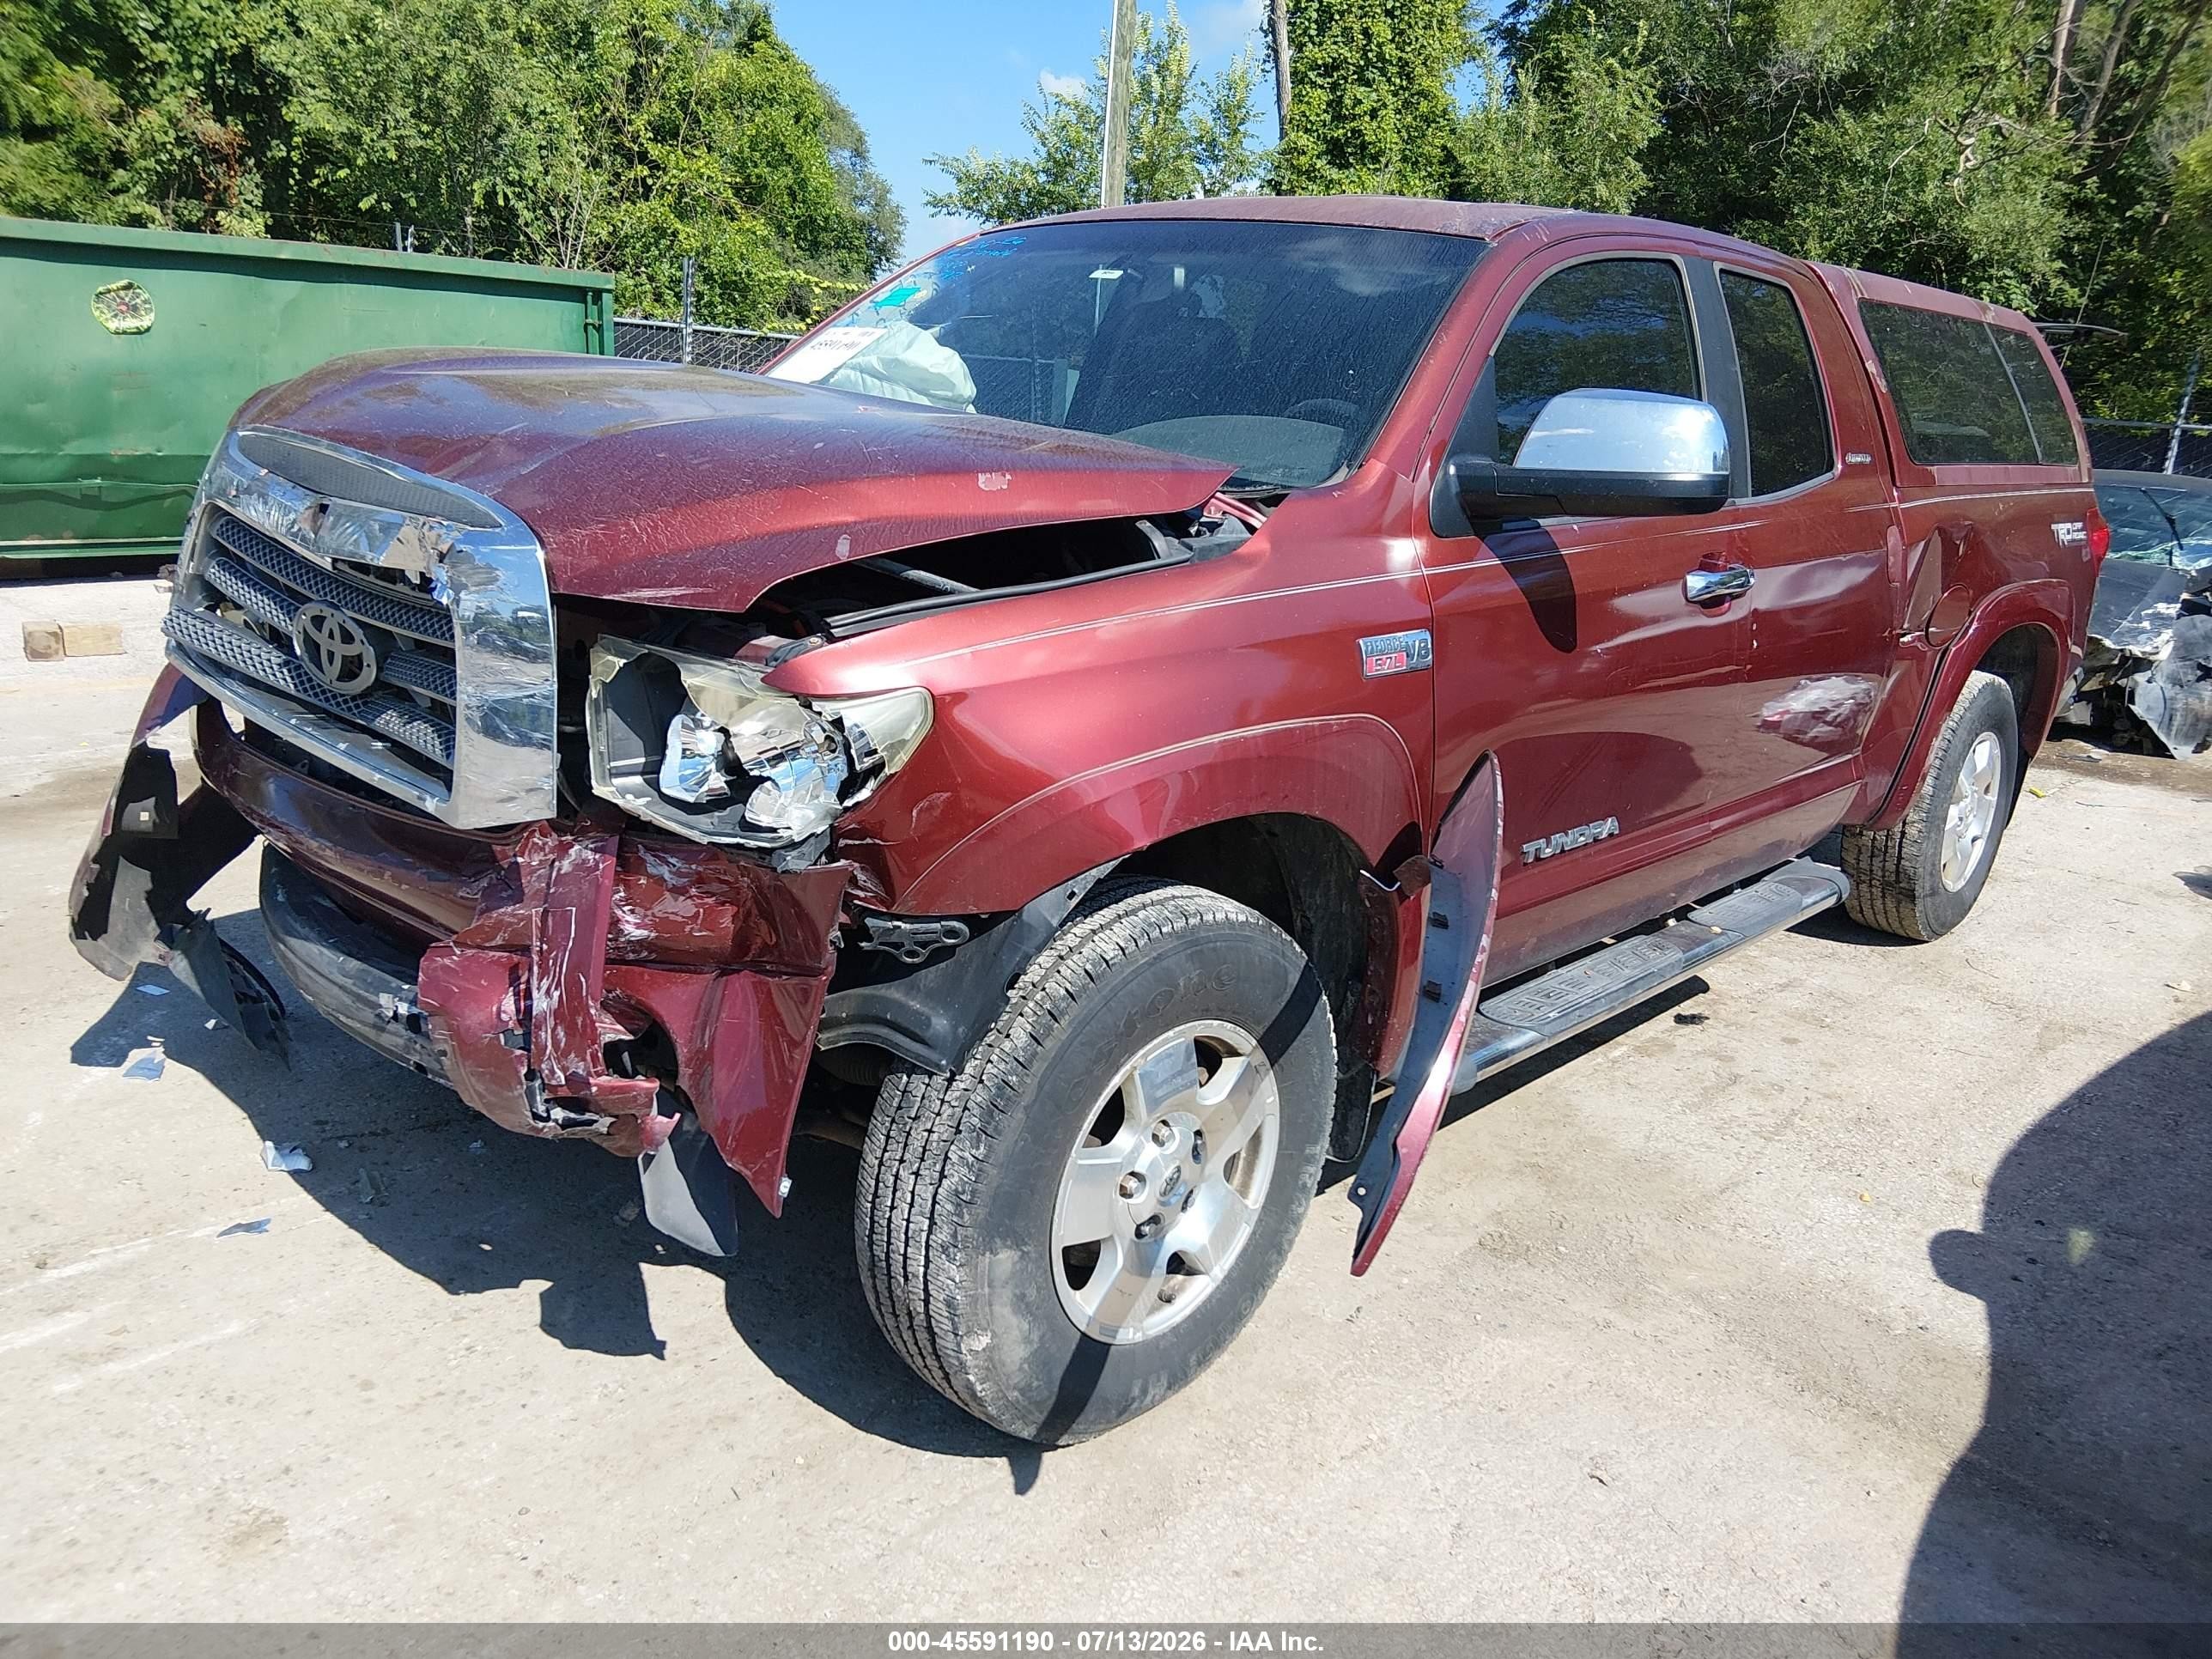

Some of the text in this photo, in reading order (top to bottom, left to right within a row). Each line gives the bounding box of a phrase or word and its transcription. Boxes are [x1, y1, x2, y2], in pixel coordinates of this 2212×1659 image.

[2051, 523, 2072, 548] TRD
[1407, 638, 1431, 663] V8
[1522, 817, 1620, 864] TUNDRA
